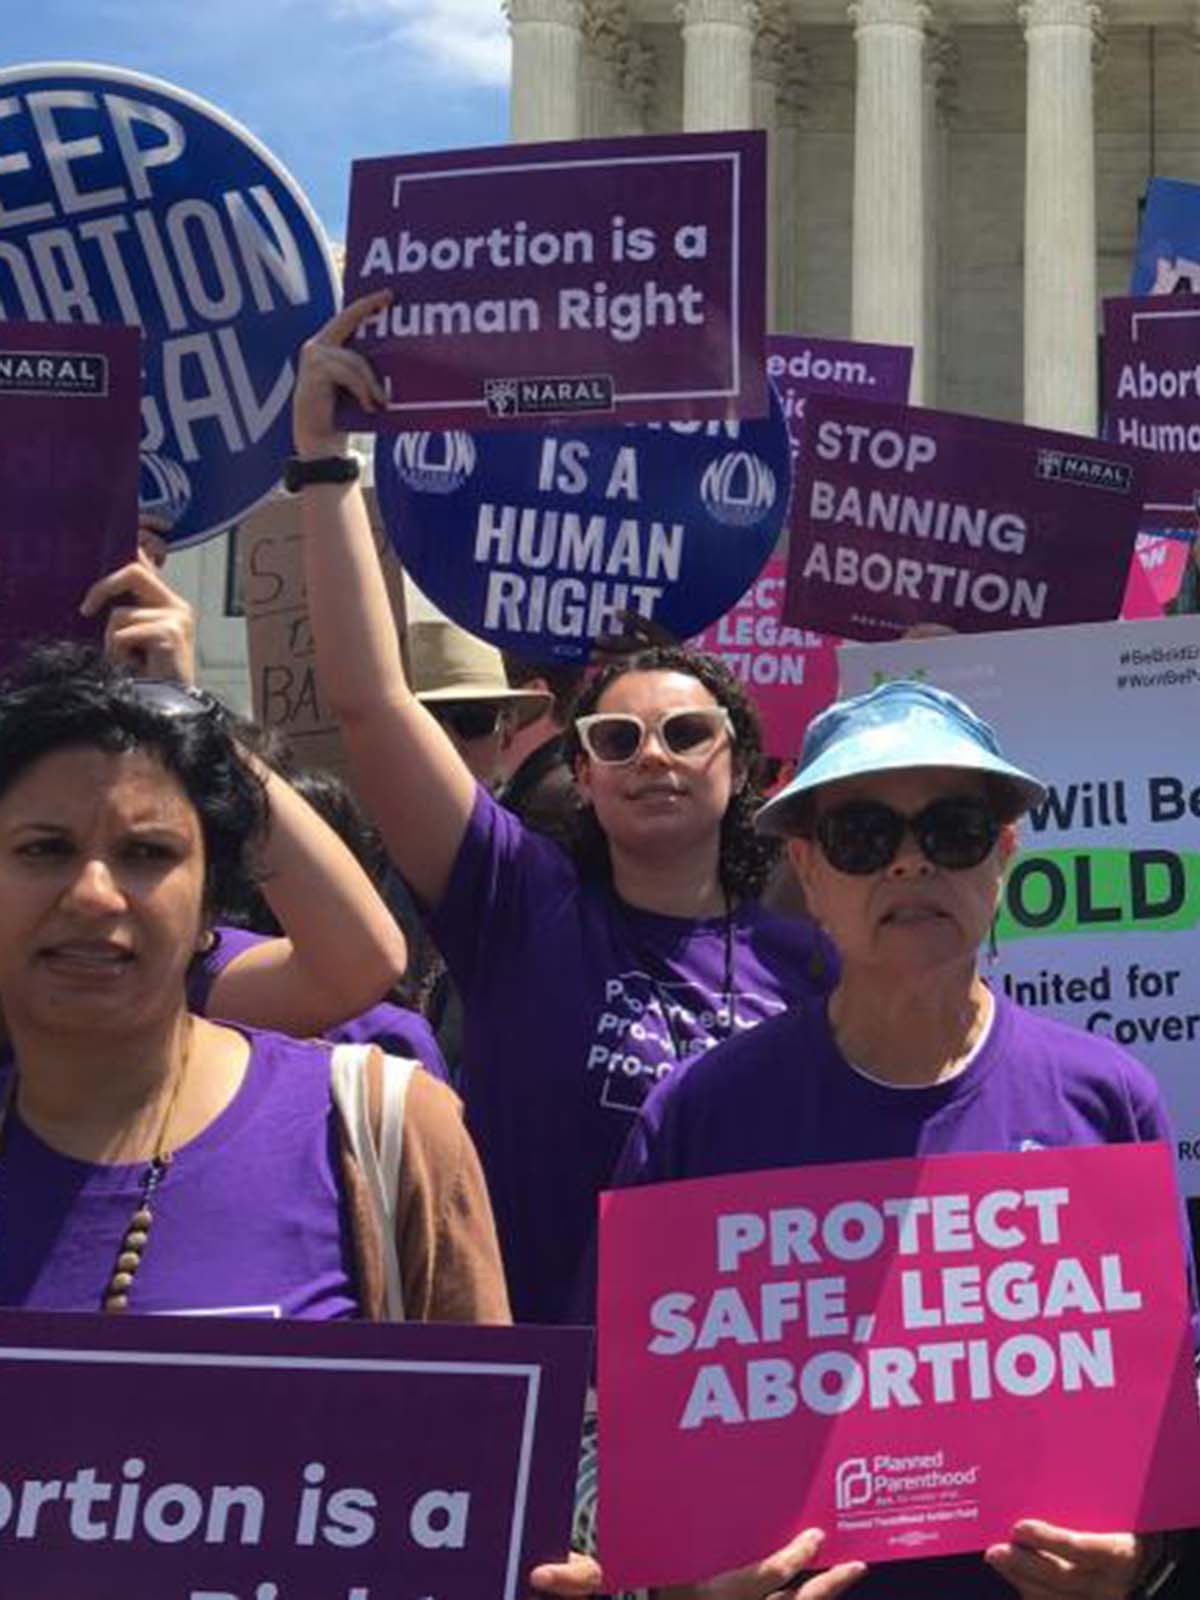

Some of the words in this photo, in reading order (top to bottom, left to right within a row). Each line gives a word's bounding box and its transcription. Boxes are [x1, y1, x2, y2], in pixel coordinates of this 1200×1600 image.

[360, 224, 593, 278] Abortion
[611, 216, 655, 262] is
[675, 226, 707, 259] a
[356, 291, 541, 341] Human
[558, 282, 705, 342] Right
[521, 382, 604, 402] NARAL
[539, 439, 591, 496] IS
[605, 446, 640, 501] A
[812, 420, 937, 473] STOP
[1064, 459, 1128, 484] NARAL
[475, 504, 685, 581] HUMAN
[810, 481, 1028, 556] BANNING
[803, 542, 1048, 620] ABORTION
[1031, 780, 1127, 832] Will
[1127, 964, 1180, 998] for
[716, 1188, 1070, 1272] PROTECT
[648, 1277, 875, 1355] SAFE,
[902, 1255, 1143, 1330] LEGAL
[680, 1328, 1115, 1429] ABORTION
[873, 1452, 944, 1473] Planned
[874, 1468, 980, 1492] Parenthood
[0, 1459, 264, 1541] rtion
[297, 1463, 377, 1545] is
[411, 1489, 470, 1547] a
